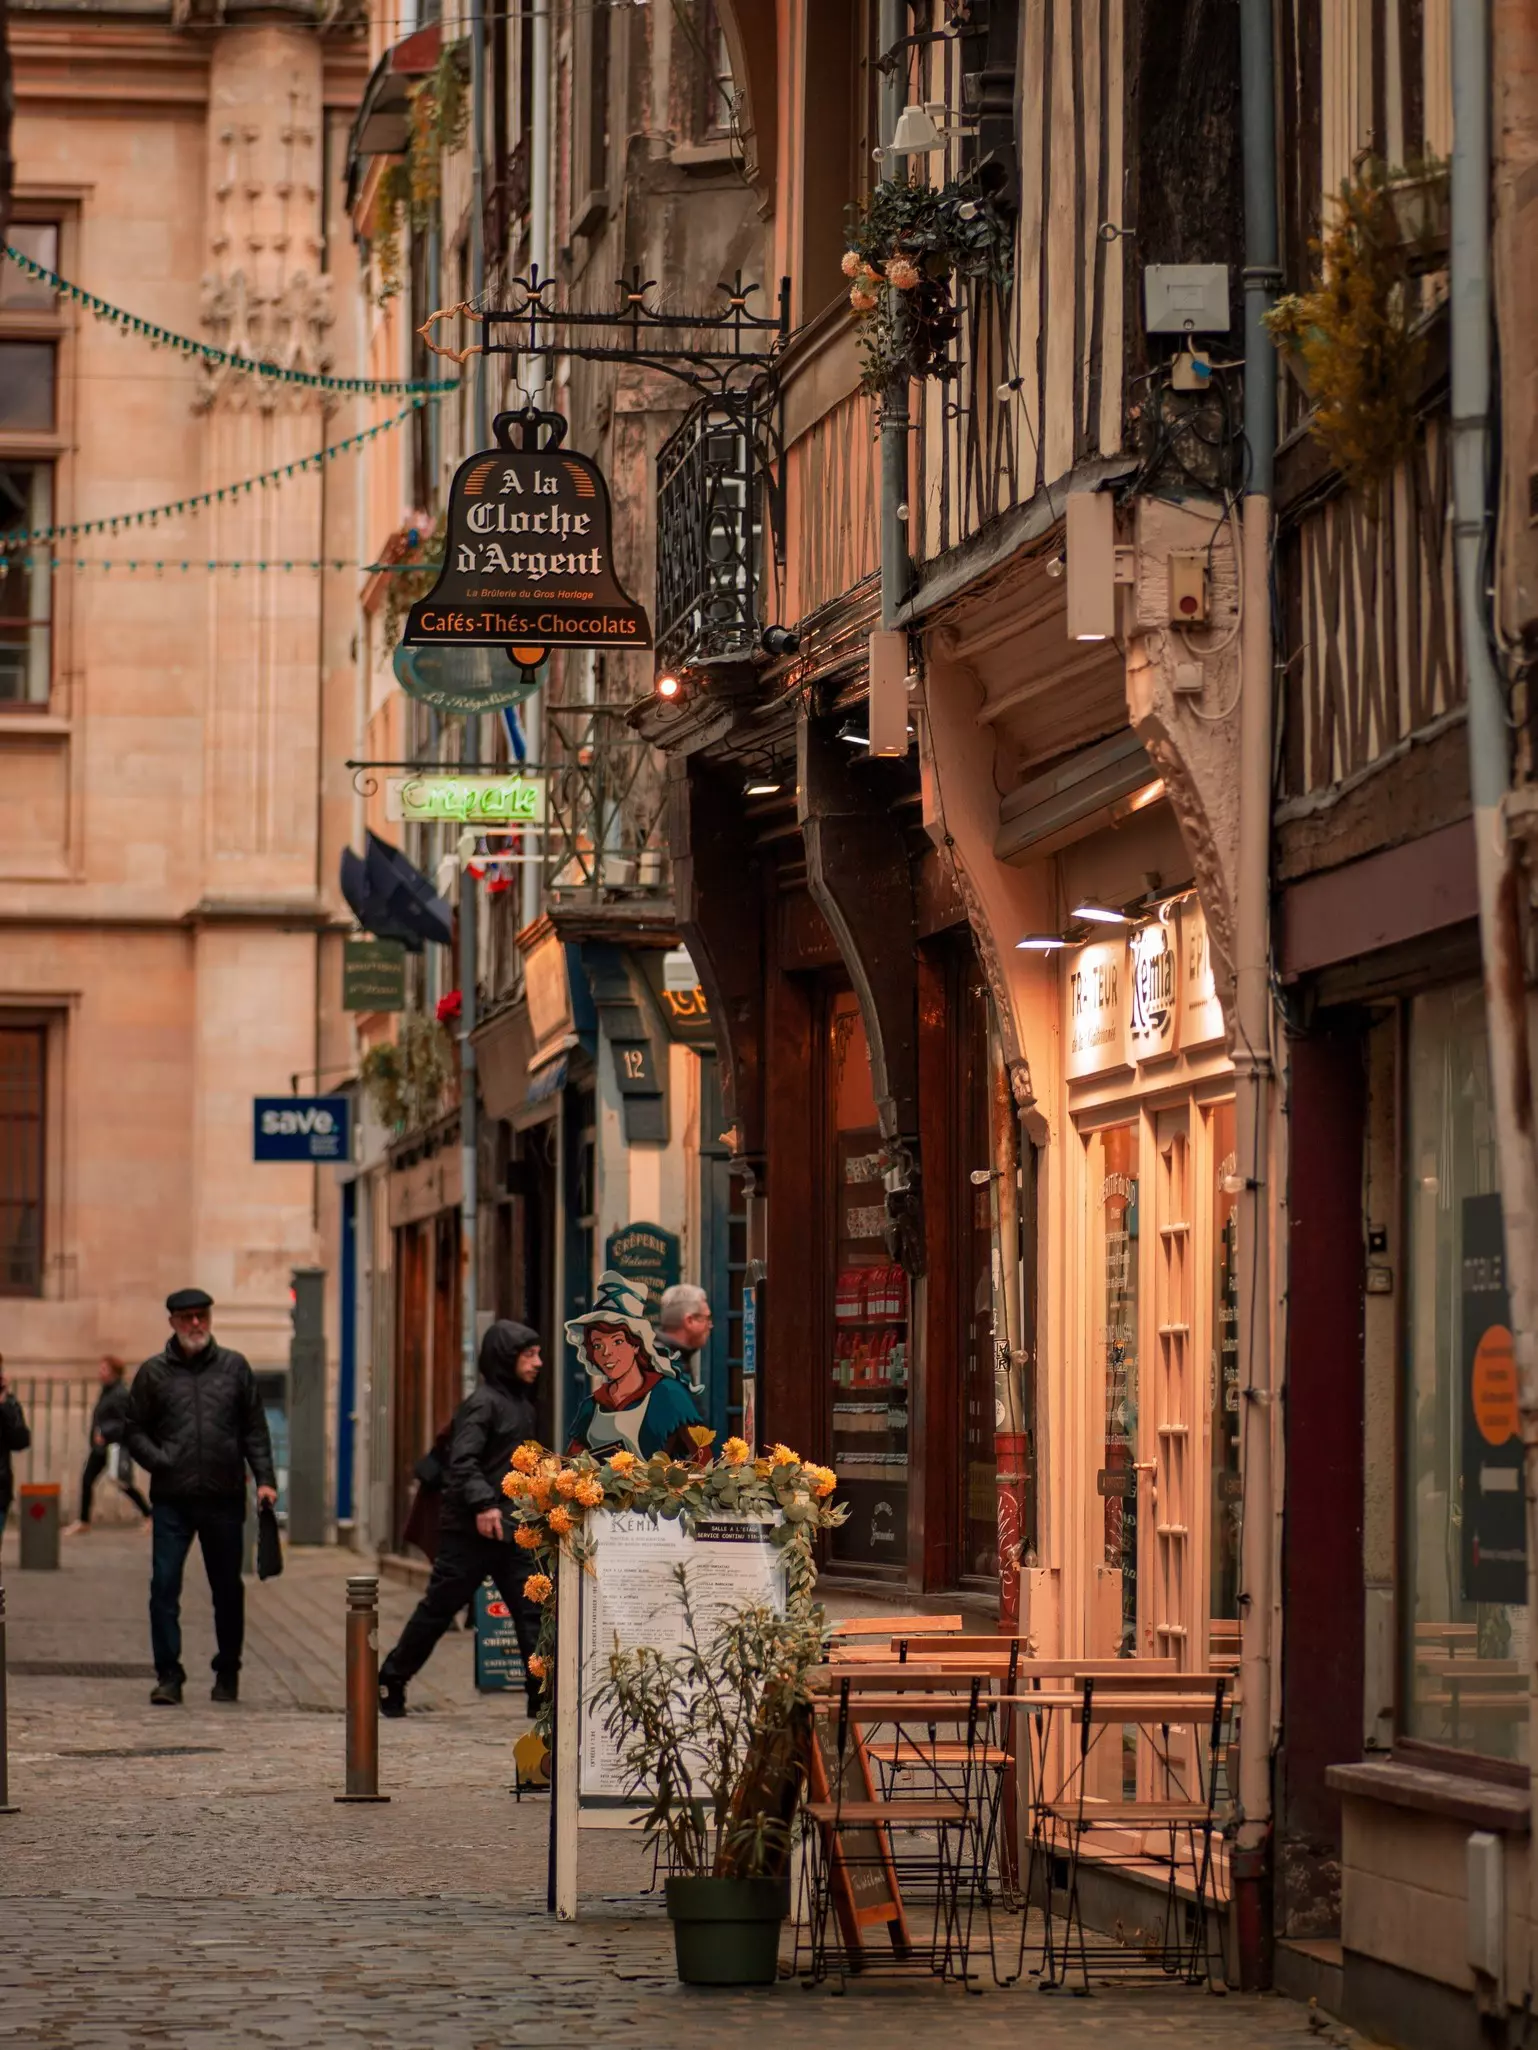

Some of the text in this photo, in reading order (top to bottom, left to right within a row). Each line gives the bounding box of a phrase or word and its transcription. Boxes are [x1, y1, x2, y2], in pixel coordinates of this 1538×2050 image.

[500, 469, 559, 495] A la
[466, 502, 592, 542] Cloche
[456, 542, 603, 581] d'Argent
[466, 588, 594, 601] La Brûlerie du Gros Horloge
[420, 612, 636, 634] Cafés-Thés-Chocolats
[1071, 965, 1118, 1019] TRTEUR
[624, 1050, 645, 1079] 12
[613, 1230, 667, 1257] CRÊPERIE
